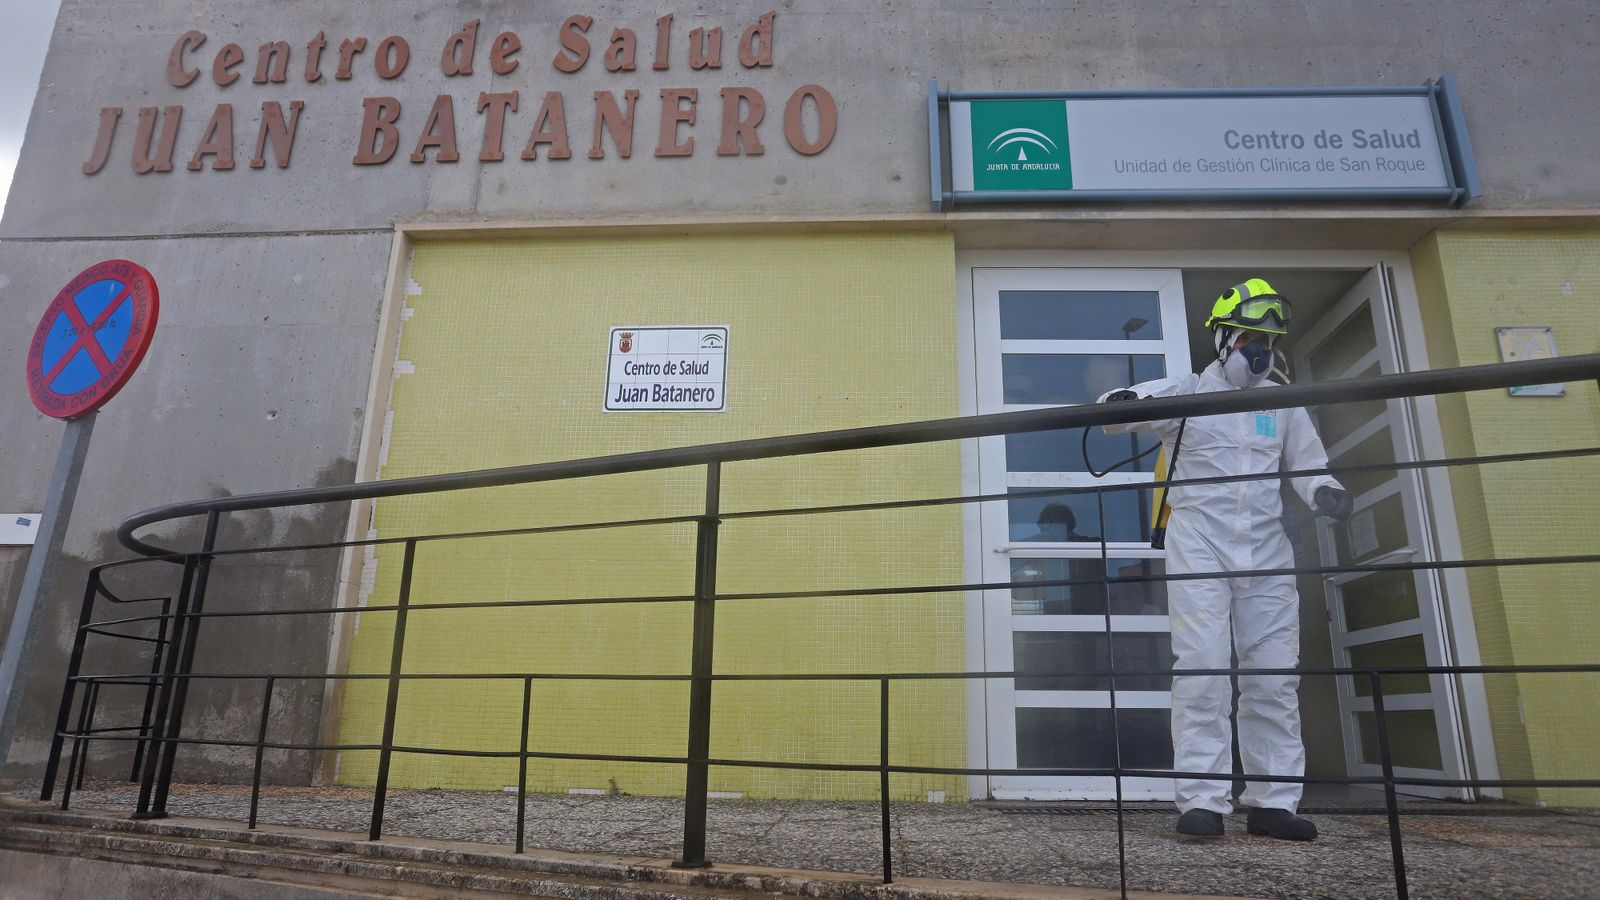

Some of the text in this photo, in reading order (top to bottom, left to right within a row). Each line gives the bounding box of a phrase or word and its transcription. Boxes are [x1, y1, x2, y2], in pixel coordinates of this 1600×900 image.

[167, 11, 776, 87] Centro de Salud
[82, 84, 838, 175] JUAN BATANERO
[1224, 128, 1421, 150] Centro de Salud
[986, 163, 1009, 171] JUNTA
[1011, 163, 1020, 171] DE
[1114, 157, 1425, 174] Unidad de Gestión Clínica de San Roque
[624, 360, 710, 375] Centro de Salud
[32, 349, 134, 410] RETIRADA CON GRUA
[615, 384, 715, 403] Juan Batanero
